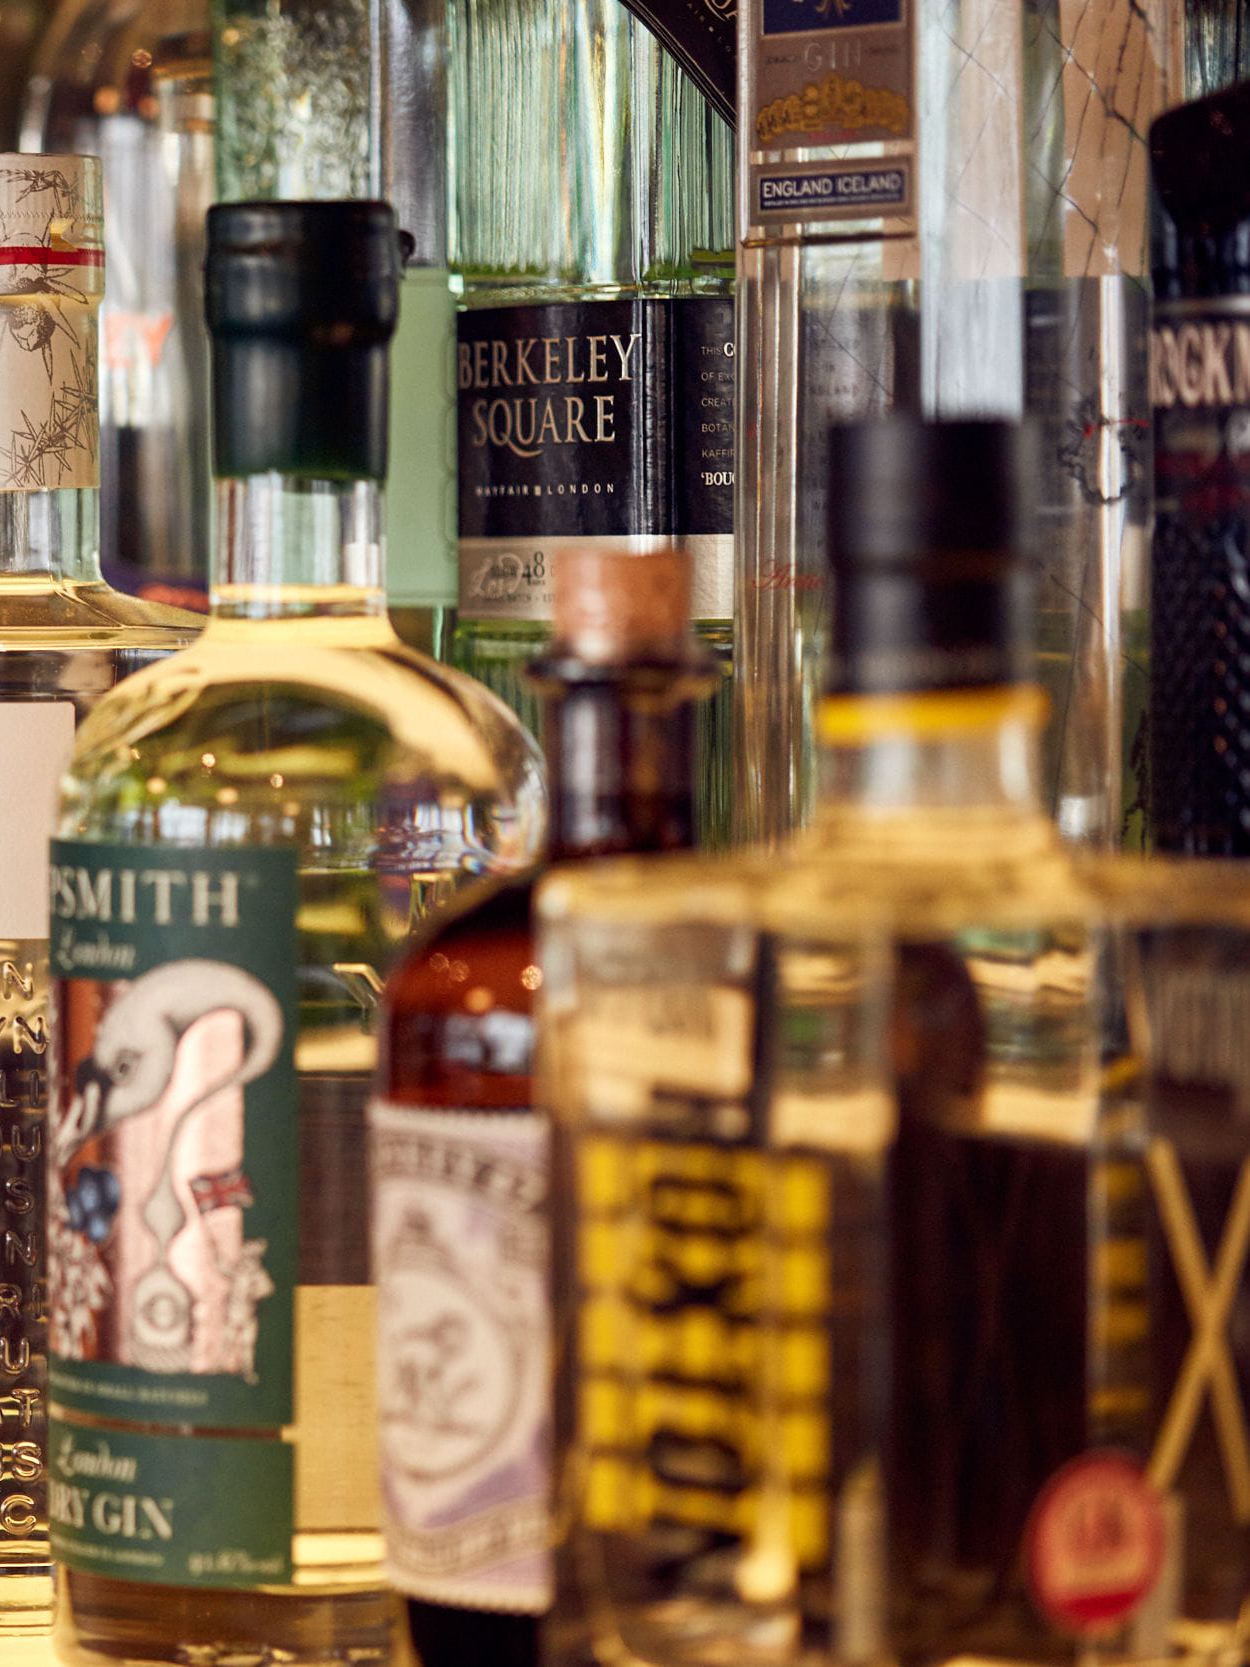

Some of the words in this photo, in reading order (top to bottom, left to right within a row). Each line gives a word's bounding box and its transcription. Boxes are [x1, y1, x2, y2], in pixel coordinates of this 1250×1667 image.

[762, 176, 833, 199] ENGLAND
[837, 169, 902, 194] ICELAND
[458, 334, 642, 389] BERKELEY
[701, 346, 722, 356] THIS
[701, 371, 715, 382] OF
[472, 396, 616, 458] SQUARE
[475, 484, 530, 498] MAYFAIR
[547, 482, 615, 496] LONDON
[90, 1490, 175, 1542] GIN
